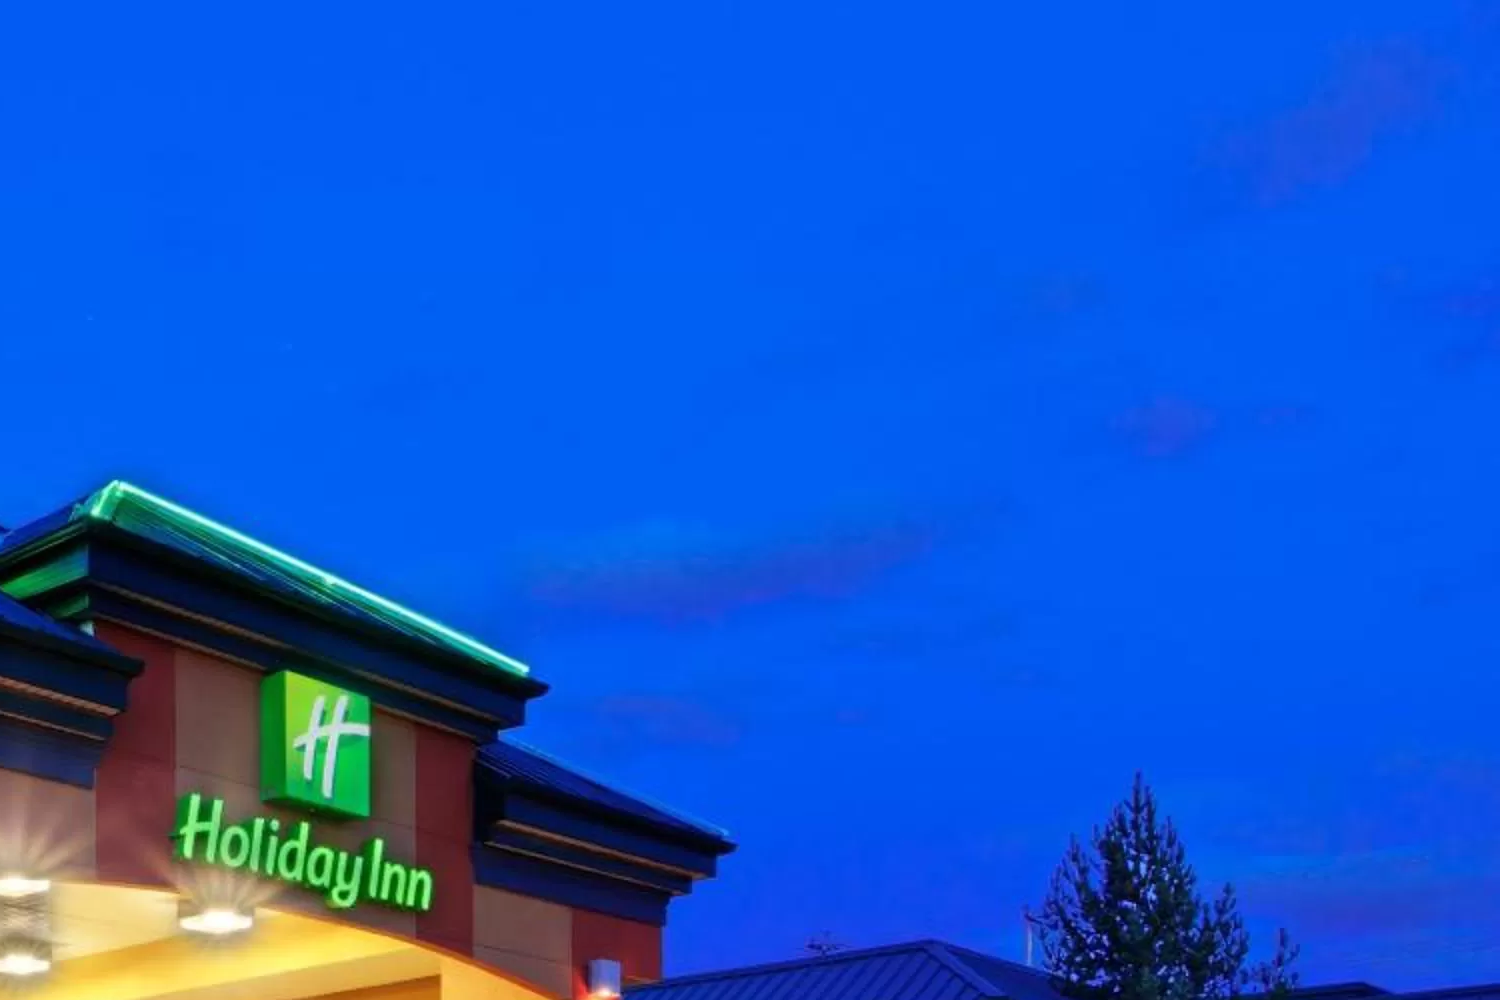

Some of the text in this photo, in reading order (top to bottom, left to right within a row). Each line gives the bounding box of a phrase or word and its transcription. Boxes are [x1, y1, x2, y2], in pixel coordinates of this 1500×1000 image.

[294, 695, 369, 798] H
[180, 793, 432, 910] Holiday Inn
